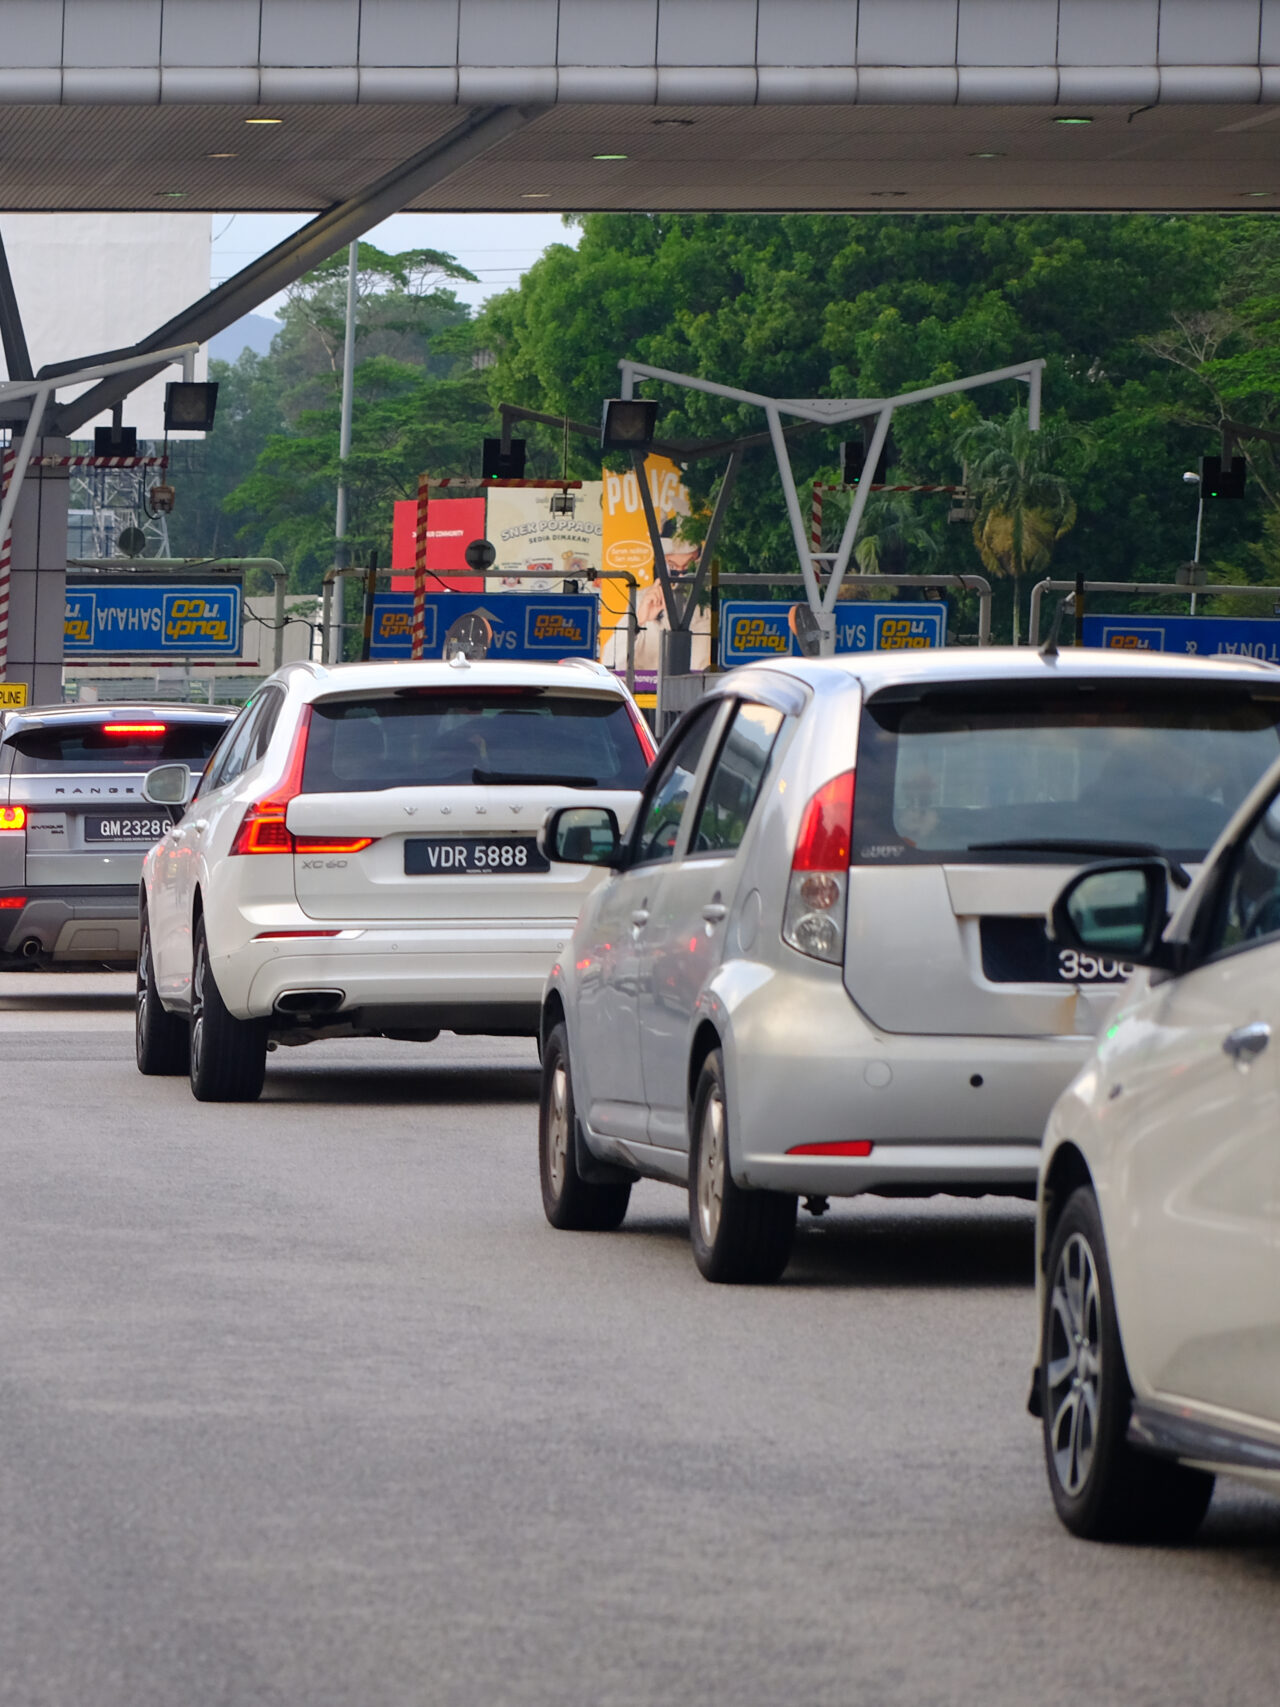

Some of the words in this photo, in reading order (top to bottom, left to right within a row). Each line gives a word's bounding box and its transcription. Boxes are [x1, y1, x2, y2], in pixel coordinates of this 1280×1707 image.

[501, 523, 537, 541] SNEK
[529, 535, 550, 544] SEDIA
[97, 607, 162, 631] SAHAJA
[166, 620, 228, 640] Touch
[534, 626, 583, 641] Touch
[428, 846, 468, 868] VDR
[474, 845, 528, 867] 5888
